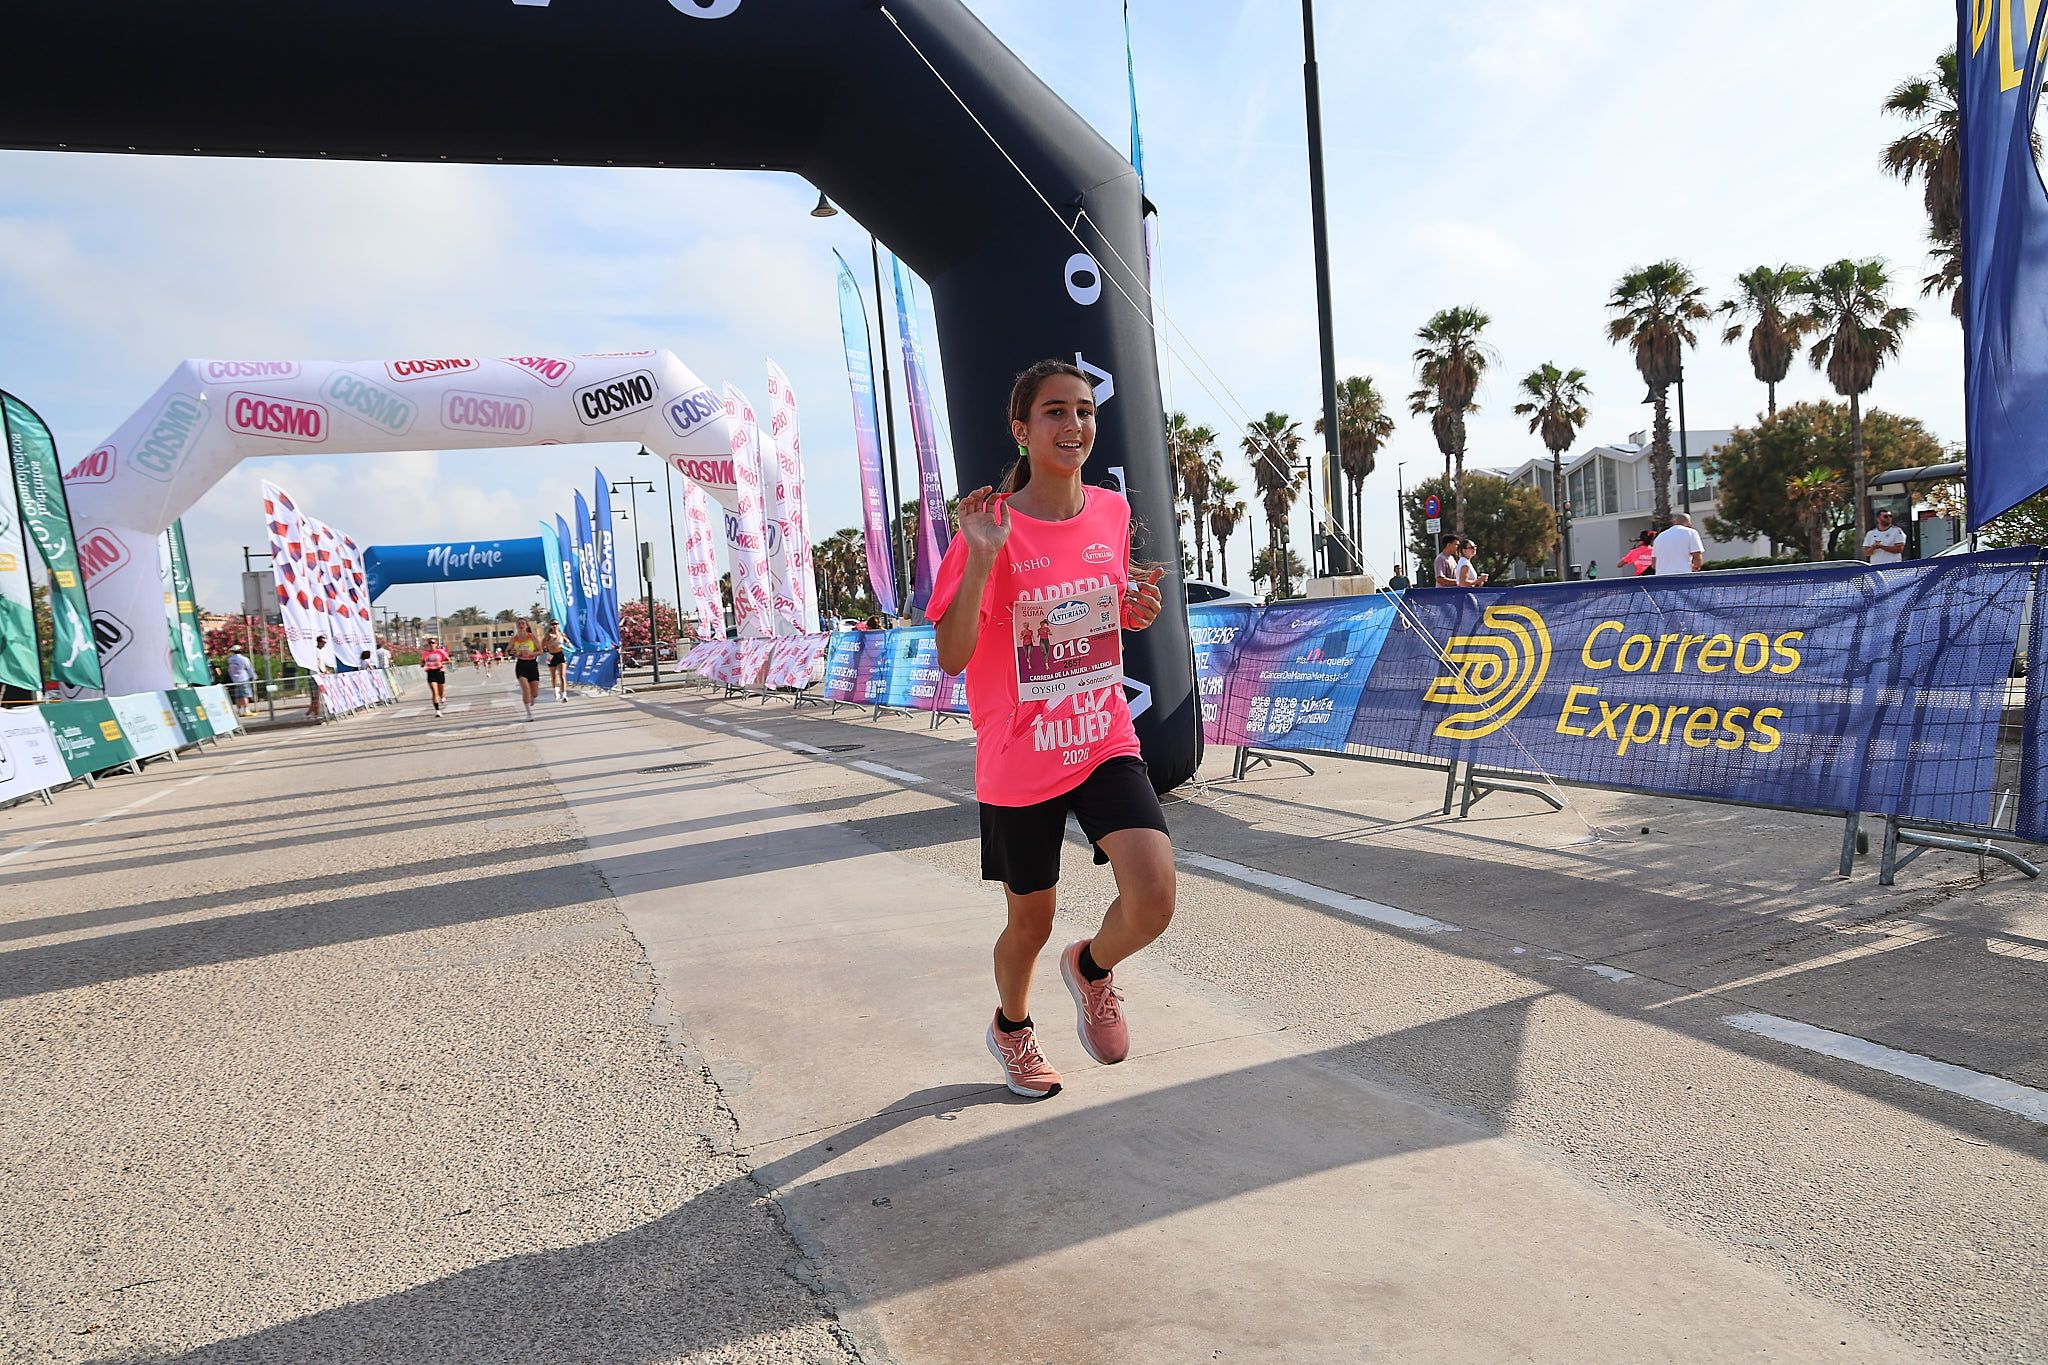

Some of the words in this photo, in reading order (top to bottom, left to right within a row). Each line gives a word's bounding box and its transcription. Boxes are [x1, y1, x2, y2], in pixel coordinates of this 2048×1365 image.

[208, 361, 292, 377] COSMO
[394, 359, 471, 376] COSMO
[509, 356, 567, 380] SMO
[329, 374, 409, 430] COSMO
[581, 374, 653, 419] COSMO
[235, 397, 321, 437] COSMO
[448, 395, 525, 430] COSMO
[671, 389, 727, 430] COSM
[136, 400, 201, 473] COSMO
[65, 450, 108, 480] SMO
[427, 545, 502, 577] Marlene
[1085, 551, 1112, 560] ASTURIANA
[1022, 610, 1045, 618] SUMA
[1051, 607, 1087, 623] ASTURIANA
[1053, 637, 1091, 660] 016
[1581, 619, 1804, 675] Correos
[1029, 673, 1054, 682] CARRERA
[1054, 671, 1062, 679] DE
[1070, 666, 1088, 675] MUJER
[1091, 660, 1113, 670] VALENCIA
[1063, 659, 1082, 669] 2657
[1031, 682, 1066, 695] OYSHO
[1085, 673, 1114, 686] Santander
[1071, 690, 1096, 715] LA
[1034, 710, 1112, 752] MUJER
[1555, 685, 1784, 757] Express
